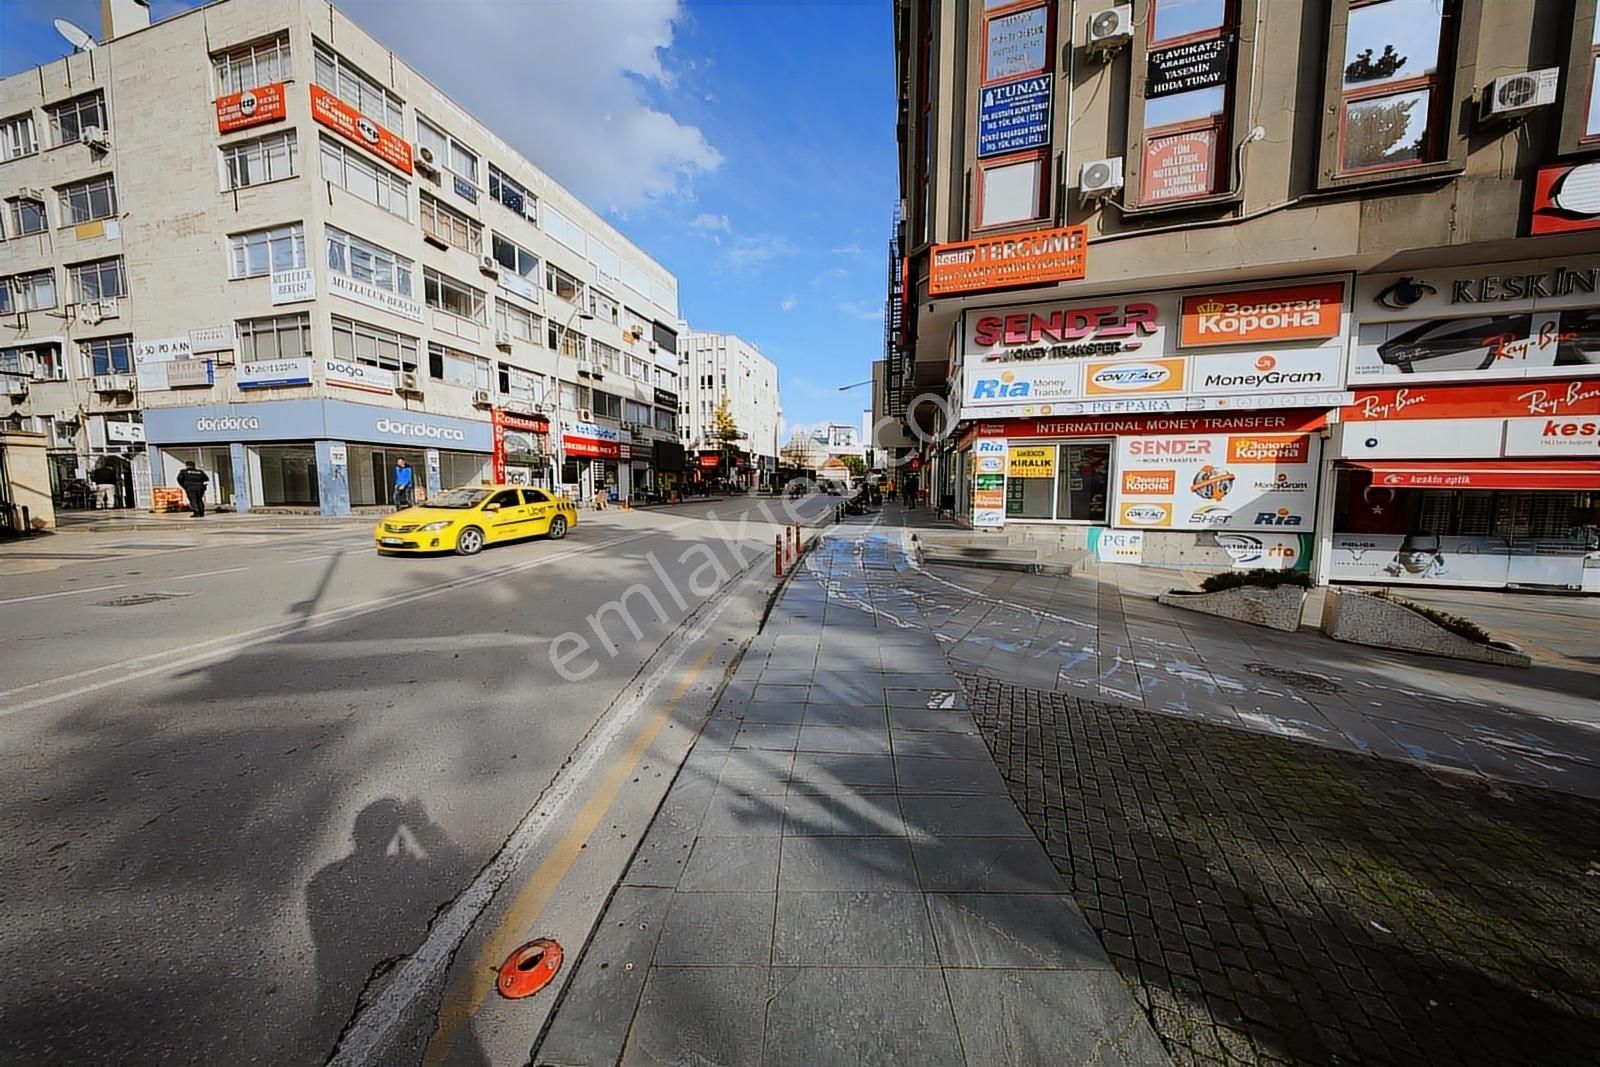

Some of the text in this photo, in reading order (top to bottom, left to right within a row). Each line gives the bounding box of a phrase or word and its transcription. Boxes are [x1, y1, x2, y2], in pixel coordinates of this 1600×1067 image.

[1166, 42, 1212, 59] AVUKAT
[1160, 52, 1217, 69] ARABULUCU
[993, 78, 1049, 99] TUNAY
[1154, 72, 1220, 93] HODA TUNAY
[978, 231, 1084, 262] TERCÜME
[333, 276, 385, 303] MUTLULUK
[1225, 299, 1321, 316] Золотая
[975, 302, 1158, 346] SENDER
[1198, 311, 1320, 335] Корона
[1482, 321, 1579, 360] Ray-Ban
[973, 371, 1030, 398] Ria
[1033, 379, 1065, 388] Money
[1205, 371, 1321, 387] MoneyGram
[1033, 388, 1072, 397] Transfer
[1355, 389, 1425, 418] Ray-Ban
[1146, 419, 1198, 430] MONEY
[1203, 416, 1286, 428] TRANSFER
[1543, 420, 1600, 437] kes
[980, 441, 1003, 451] Ria
[1129, 440, 1211, 455] SENDER
[1235, 448, 1298, 459] Корона
[1250, 441, 1300, 450] Золотая
[1010, 459, 1052, 467] KİRALIK
[1126, 481, 1169, 491] Корона
[1254, 481, 1307, 489] MoneyGram
[1410, 475, 1471, 486] keskin optik
[528, 506, 547, 516] Uber
[1254, 508, 1302, 526] Ria
[1103, 535, 1125, 546] PG
[1268, 543, 1295, 557] ria
